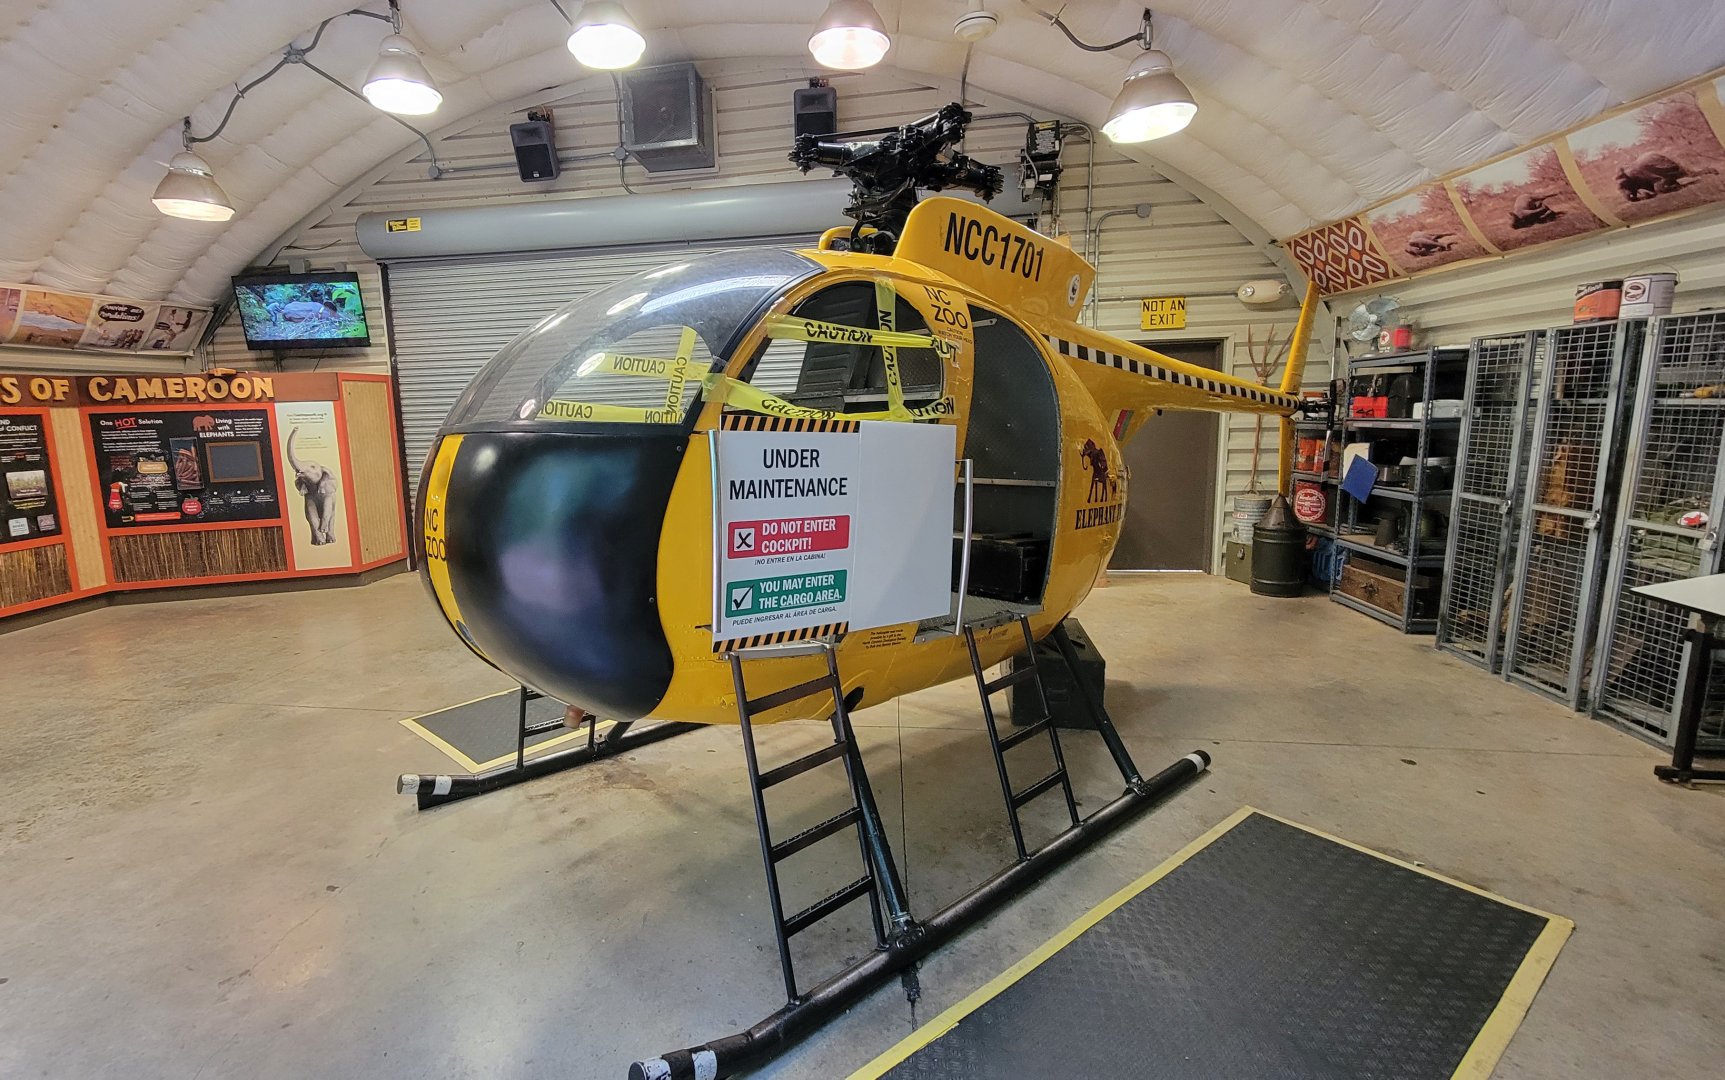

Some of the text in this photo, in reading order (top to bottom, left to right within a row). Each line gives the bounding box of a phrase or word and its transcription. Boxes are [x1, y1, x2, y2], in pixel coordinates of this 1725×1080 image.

[944, 212, 1045, 282] NCC1701
[924, 286, 951, 306] NC
[1142, 299, 1185, 312] NOT AN
[931, 304, 968, 330] ZOO
[1150, 314, 1176, 326] EXIT
[804, 321, 873, 343] CAUTION
[29, 377, 71, 402] OF
[88, 376, 275, 403] CAMEROON
[114, 417, 136, 428] HOT
[762, 448, 820, 468] UNDER
[729, 477, 848, 500] MAINTENANCE
[425, 508, 439, 532] NC
[762, 518, 836, 534] DO NOT ENTER
[426, 536, 446, 562] ZOO
[762, 537, 812, 553] COCKPIT!
[760, 574, 834, 594] YOU MAY ENTER
[758, 588, 842, 610] THE CARGO AREA.
[732, 618, 753, 626] PUEDE
[754, 614, 784, 624] INGRESAR
